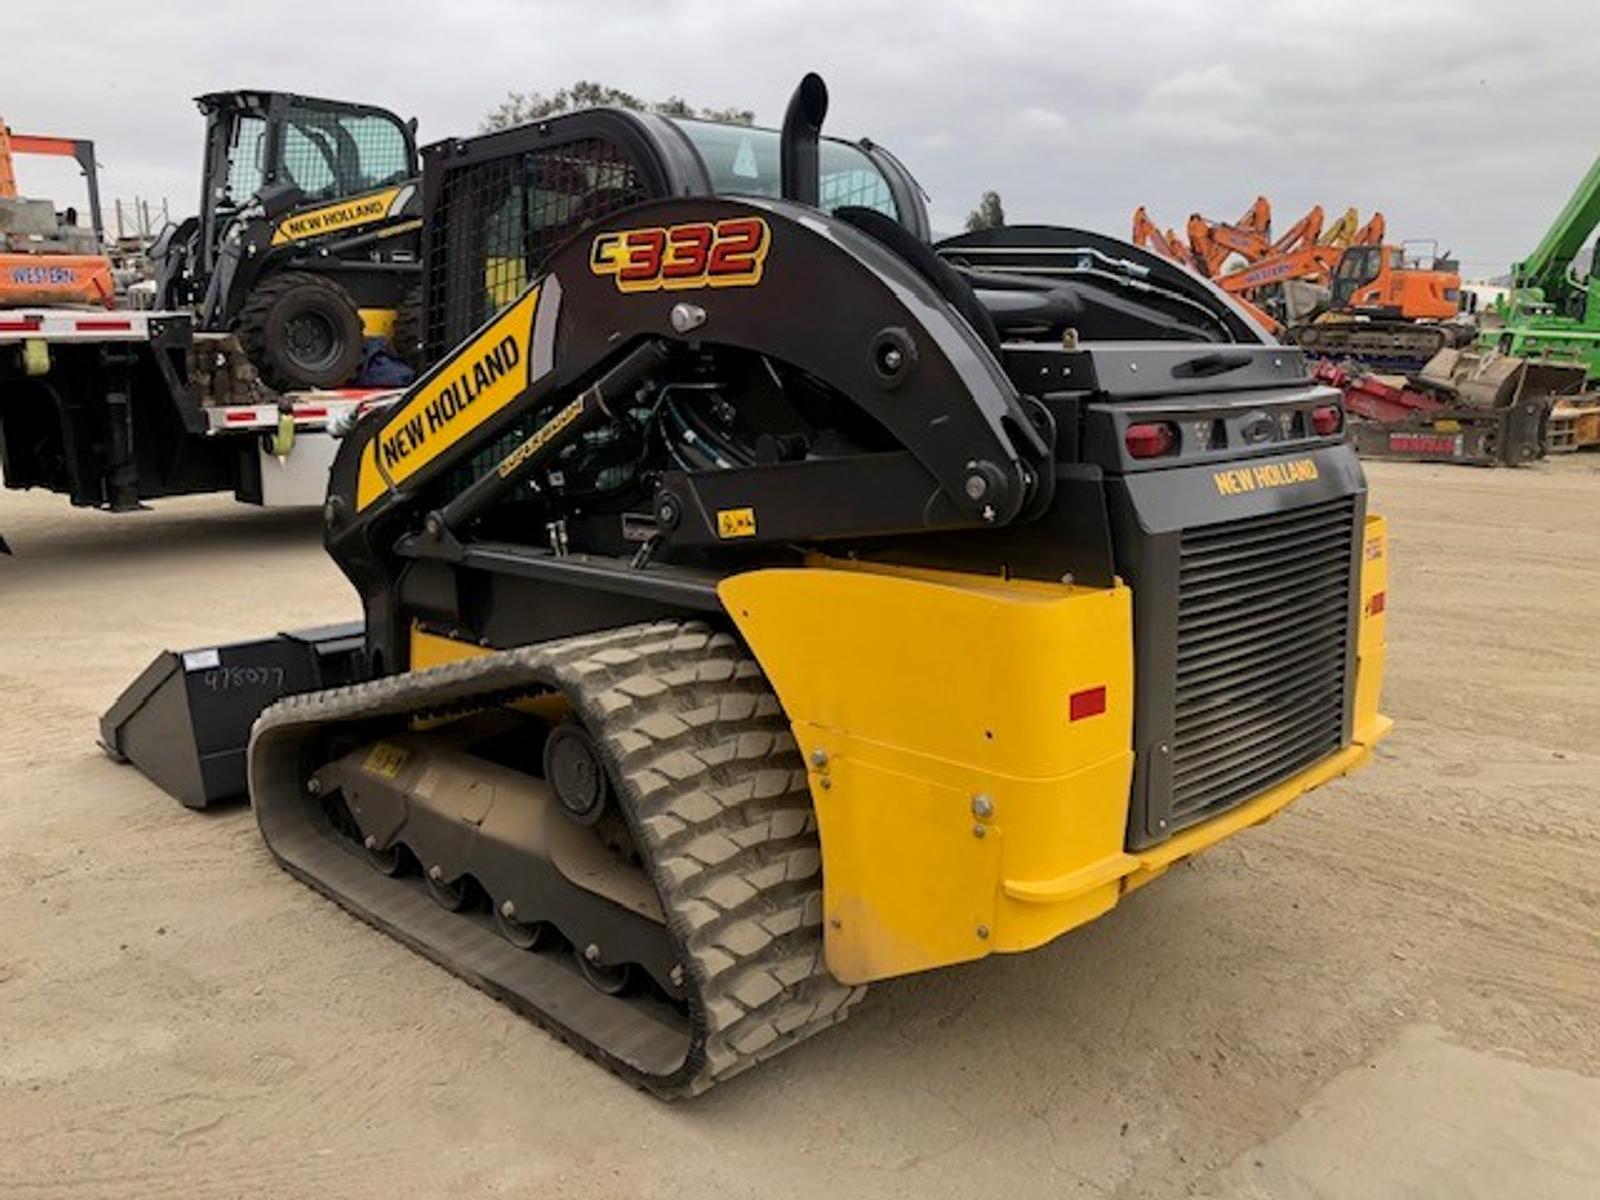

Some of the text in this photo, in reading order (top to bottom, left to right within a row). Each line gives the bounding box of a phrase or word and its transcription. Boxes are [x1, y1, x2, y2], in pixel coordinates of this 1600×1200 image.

[289, 200, 384, 235] NEW HOLLAND
[592, 217, 770, 289] C332
[382, 413, 425, 469] NEW
[424, 334, 520, 434] HOLLAND
[1213, 458, 1319, 496] NEW HOLLAND
